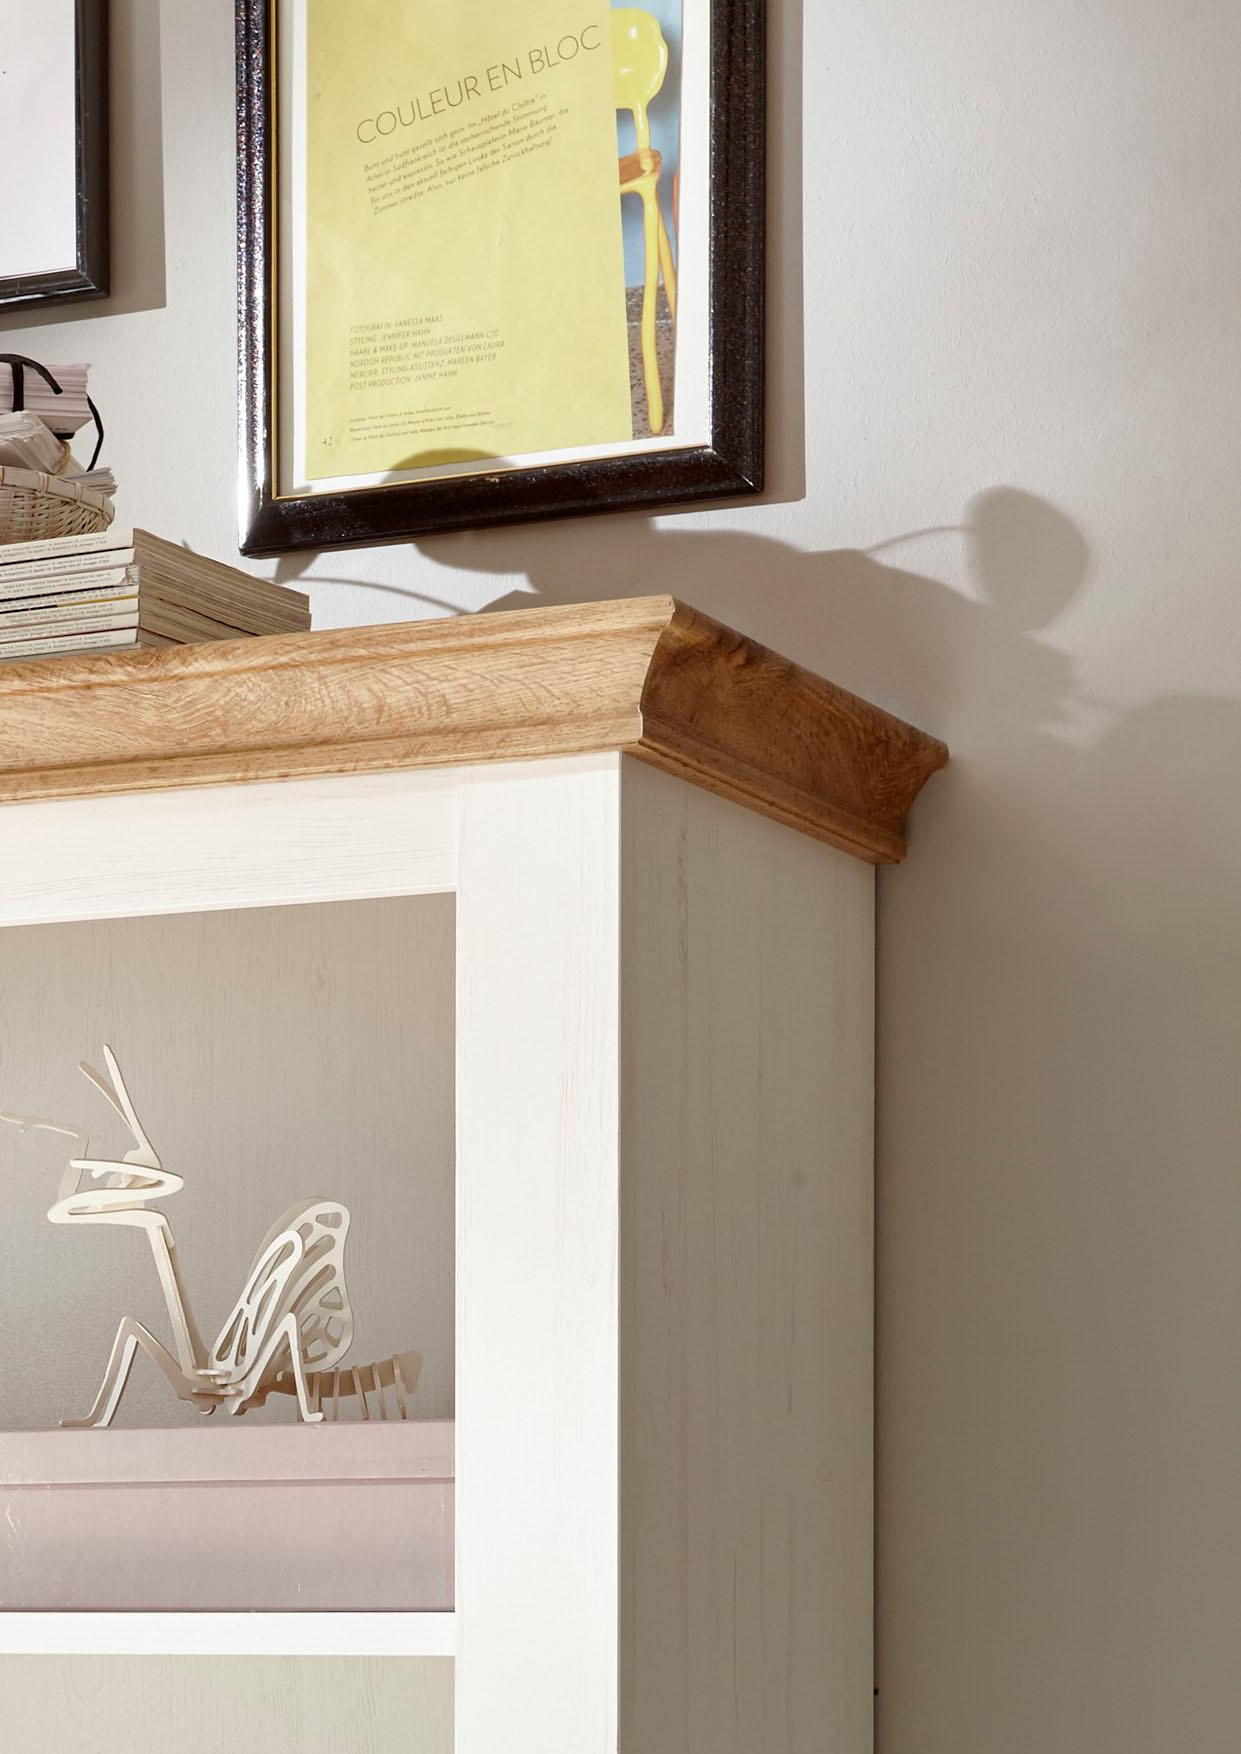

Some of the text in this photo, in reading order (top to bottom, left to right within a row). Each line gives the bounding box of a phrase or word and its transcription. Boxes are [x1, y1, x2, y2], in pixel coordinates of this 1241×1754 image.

[356, 25, 601, 143] COULEUR EN BLOC
